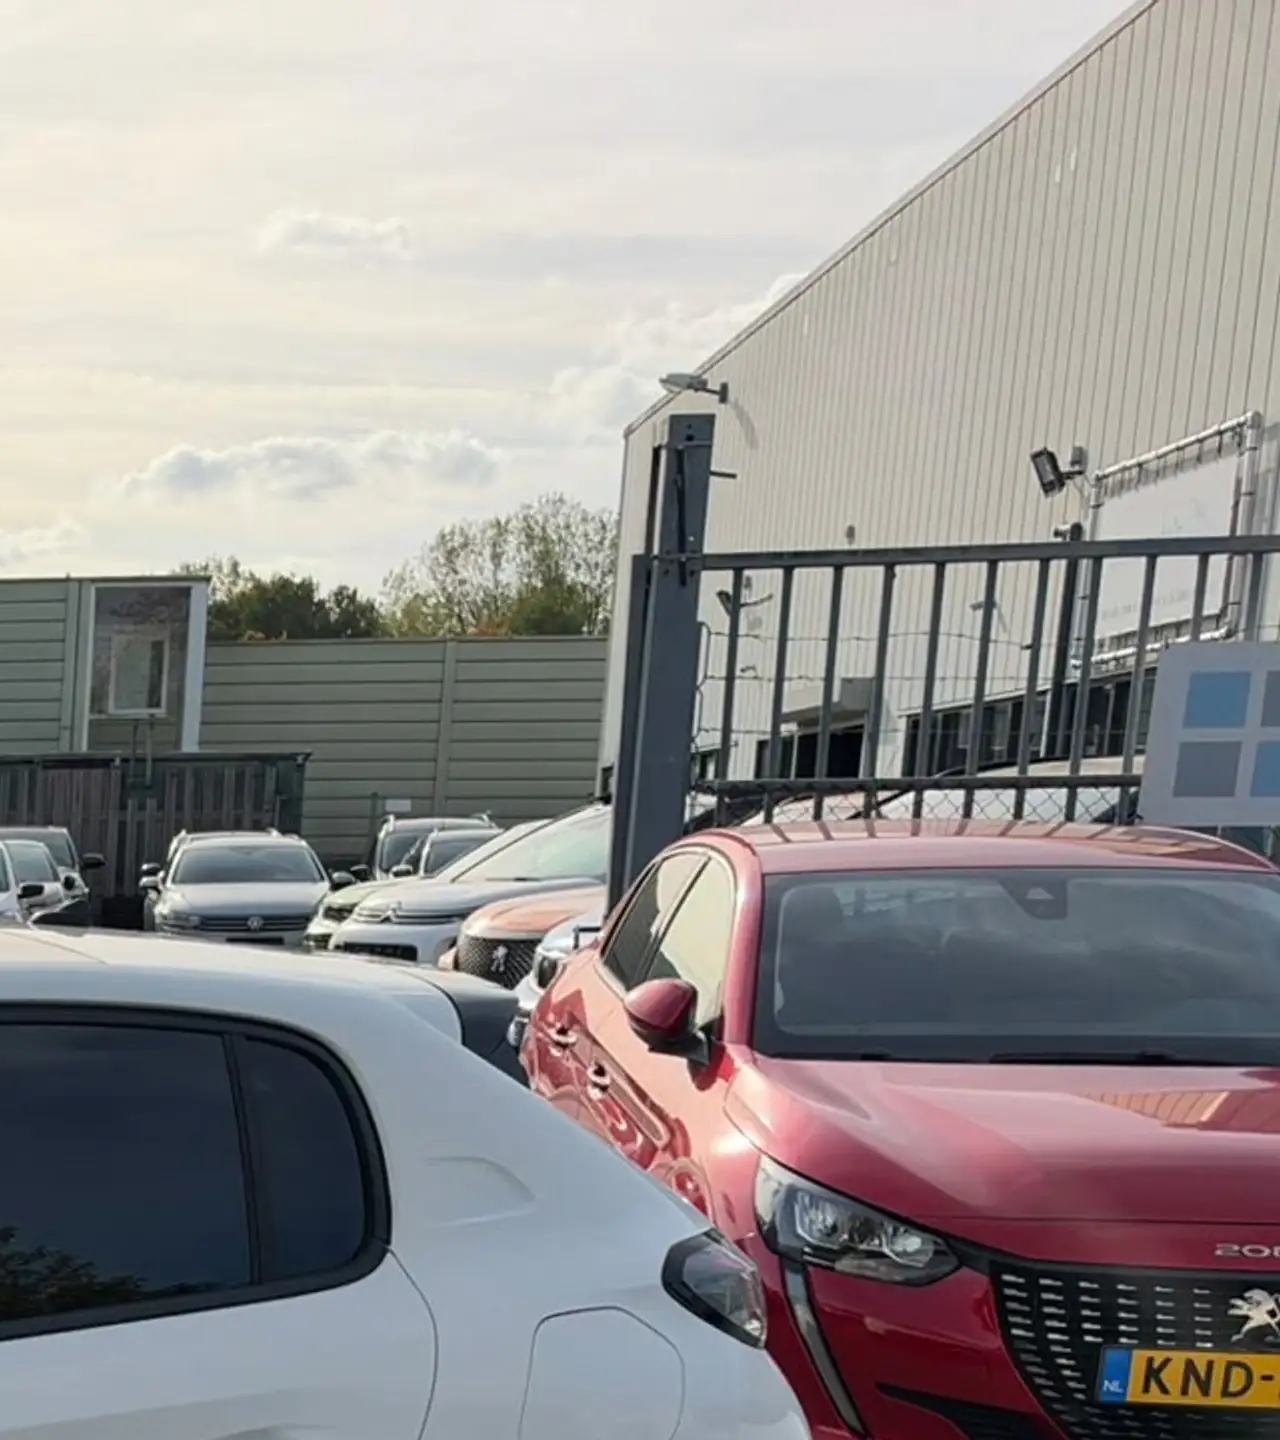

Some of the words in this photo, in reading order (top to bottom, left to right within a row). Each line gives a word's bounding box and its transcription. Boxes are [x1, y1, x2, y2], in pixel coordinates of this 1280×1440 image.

[1215, 1243, 1280, 1258] 20
[1142, 1356, 1280, 1399] KND-
[1103, 1379, 1124, 1393] NL
